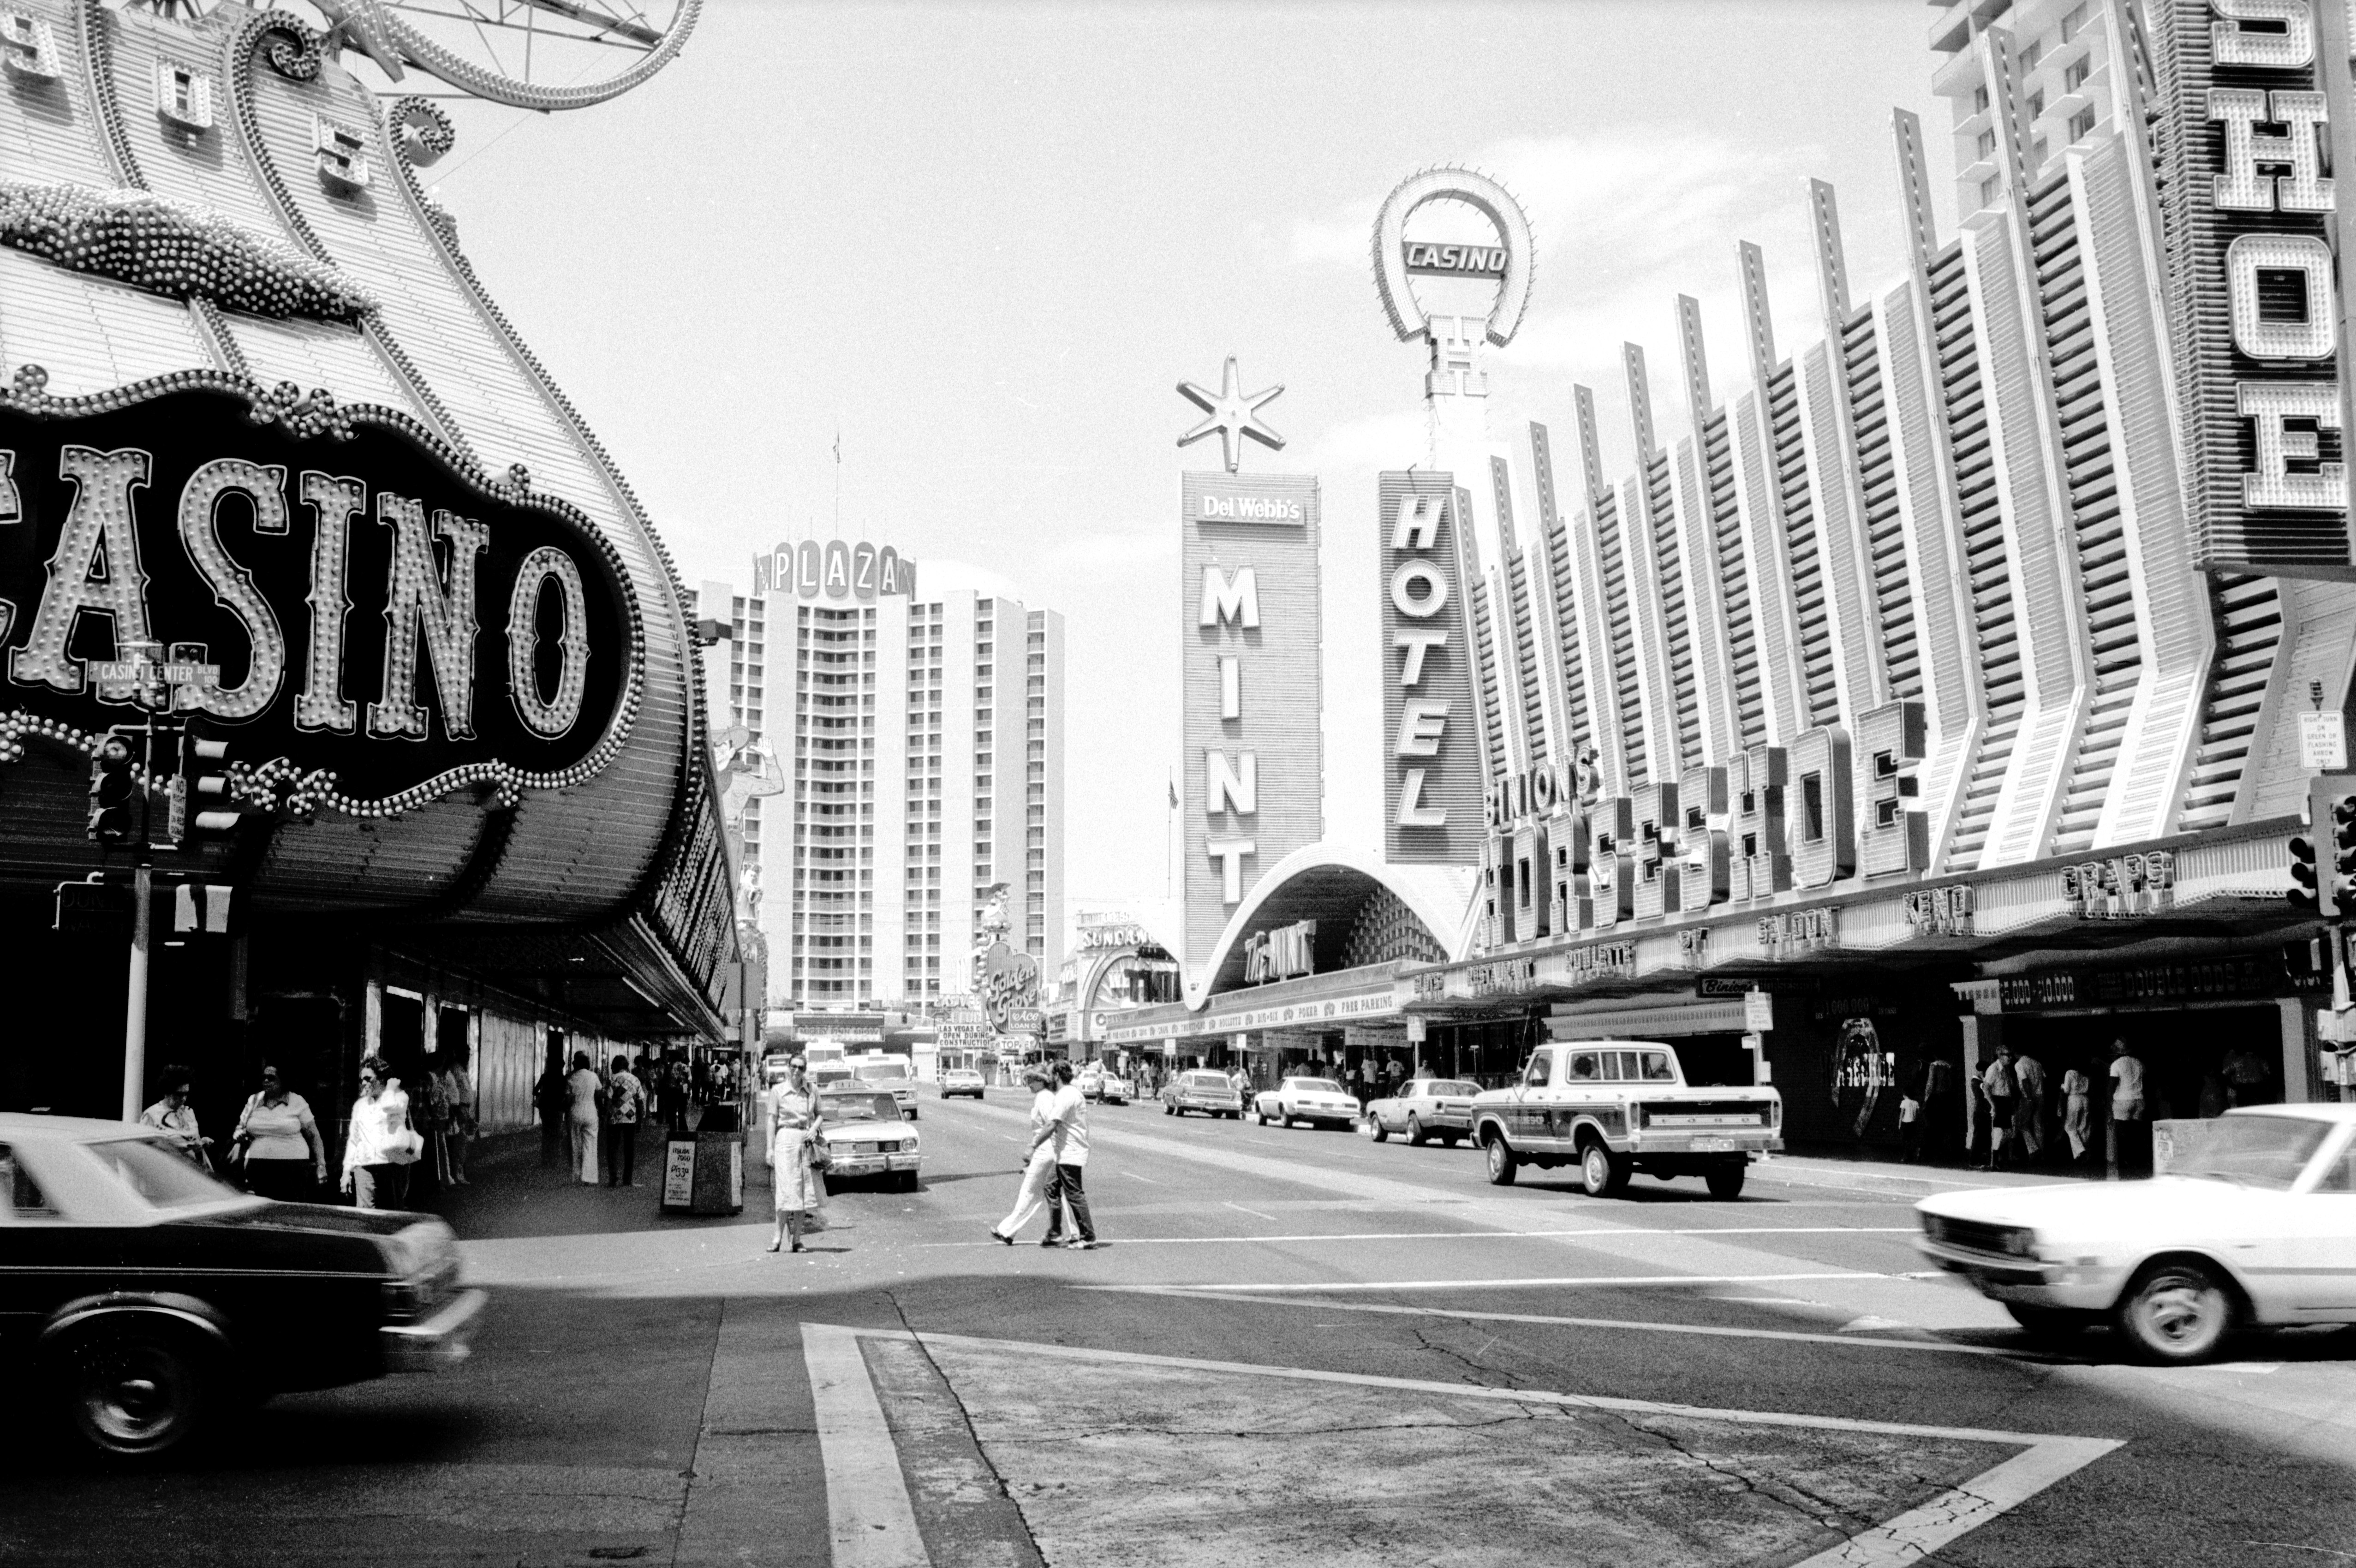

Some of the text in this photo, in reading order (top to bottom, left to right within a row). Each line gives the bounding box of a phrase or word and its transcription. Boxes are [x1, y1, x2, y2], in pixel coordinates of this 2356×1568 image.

[1407, 243, 1506, 271] CASINO
[1204, 495, 1300, 520] Del Webb's
[775, 550, 896, 592] PLAZA
[0, 444, 591, 740] ASINO
[149, 665, 193, 681] CENTER
[1390, 494, 1451, 826] HOTEL
[1199, 564, 1260, 903] MINT
[1479, 698, 1915, 949] HORSESHOE
[2061, 851, 2166, 902] CRAPS
[1902, 885, 1966, 924] KENO
[990, 965, 1036, 1002] Golden
[1705, 979, 1753, 992] Binion's
[996, 989, 1037, 1023] Goose
[1299, 1005, 1318, 1018] POKER
[1342, 995, 1393, 1013] FREE PARKING
[1219, 1016, 1241, 1028] ROULETTE
